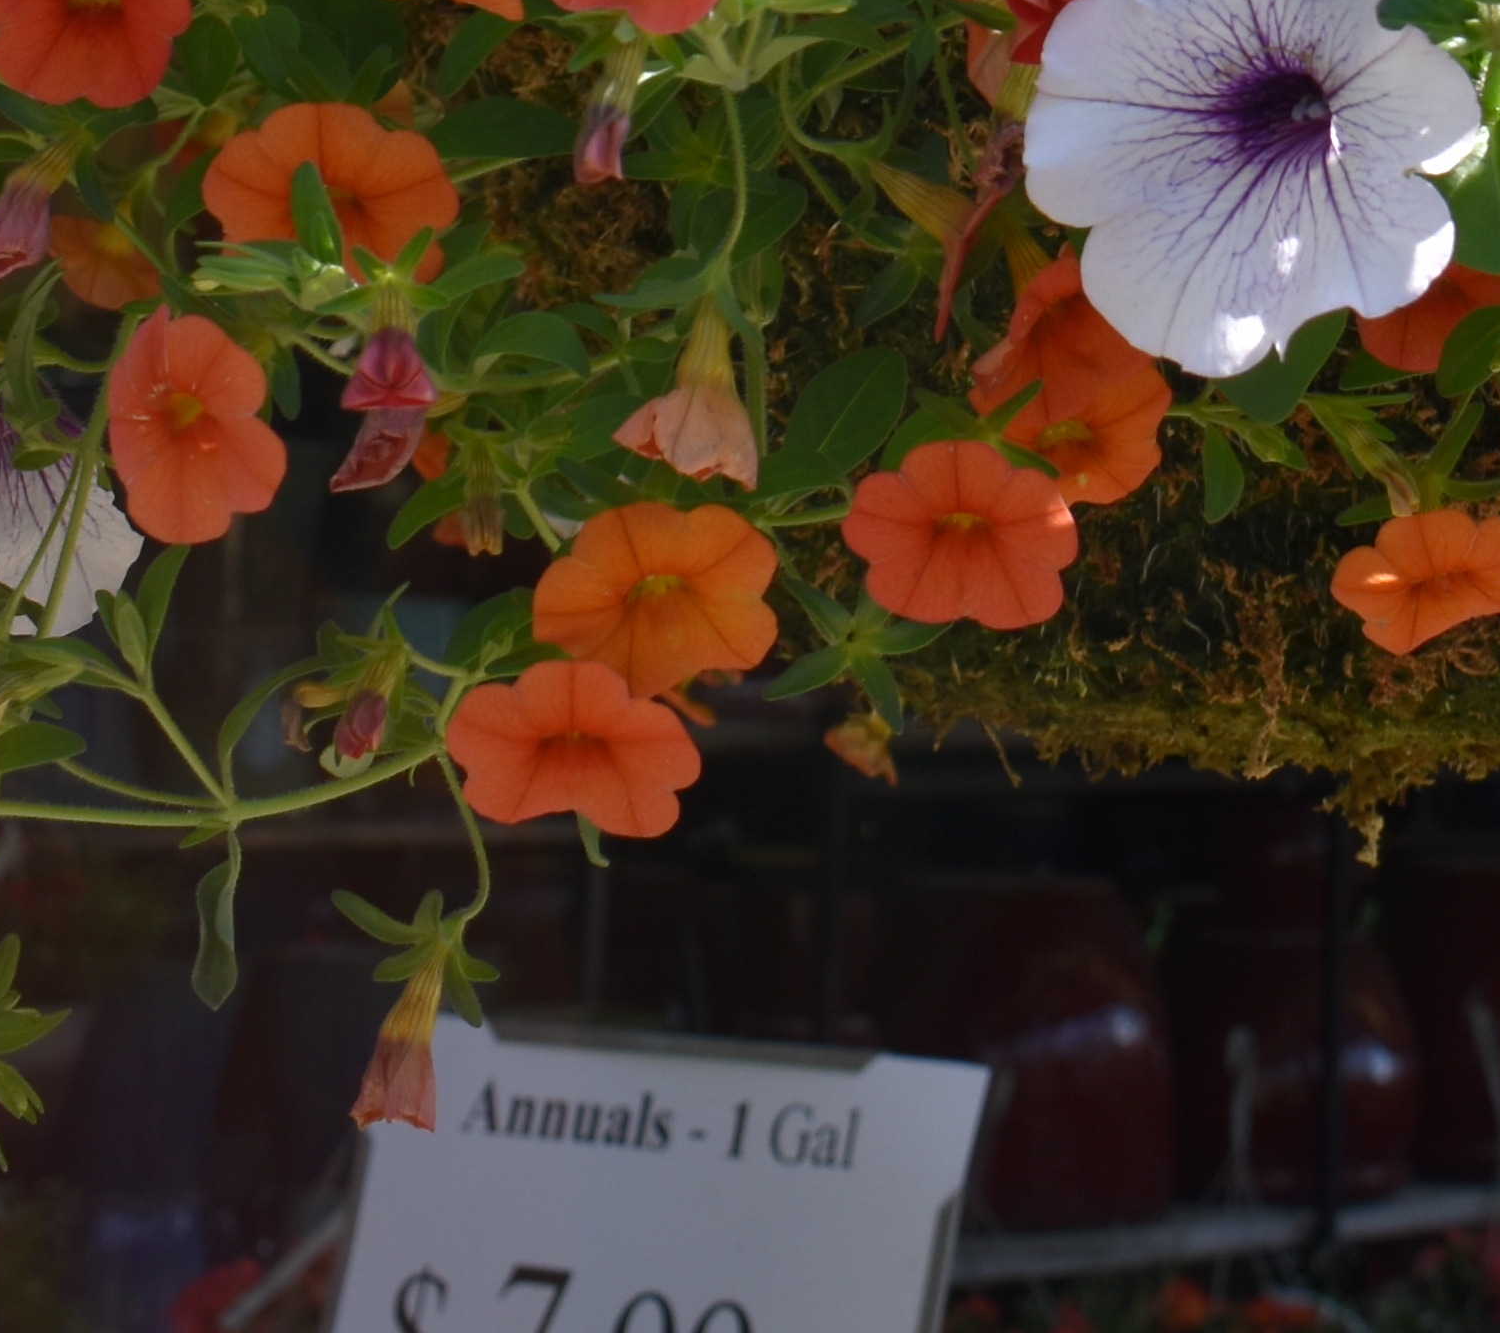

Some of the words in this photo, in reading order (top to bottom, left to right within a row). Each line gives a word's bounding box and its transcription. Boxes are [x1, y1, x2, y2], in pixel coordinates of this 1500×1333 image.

[462, 1077, 674, 1154] Annuals
[726, 1098, 751, 1161] 1
[768, 1100, 862, 1172] Gal
